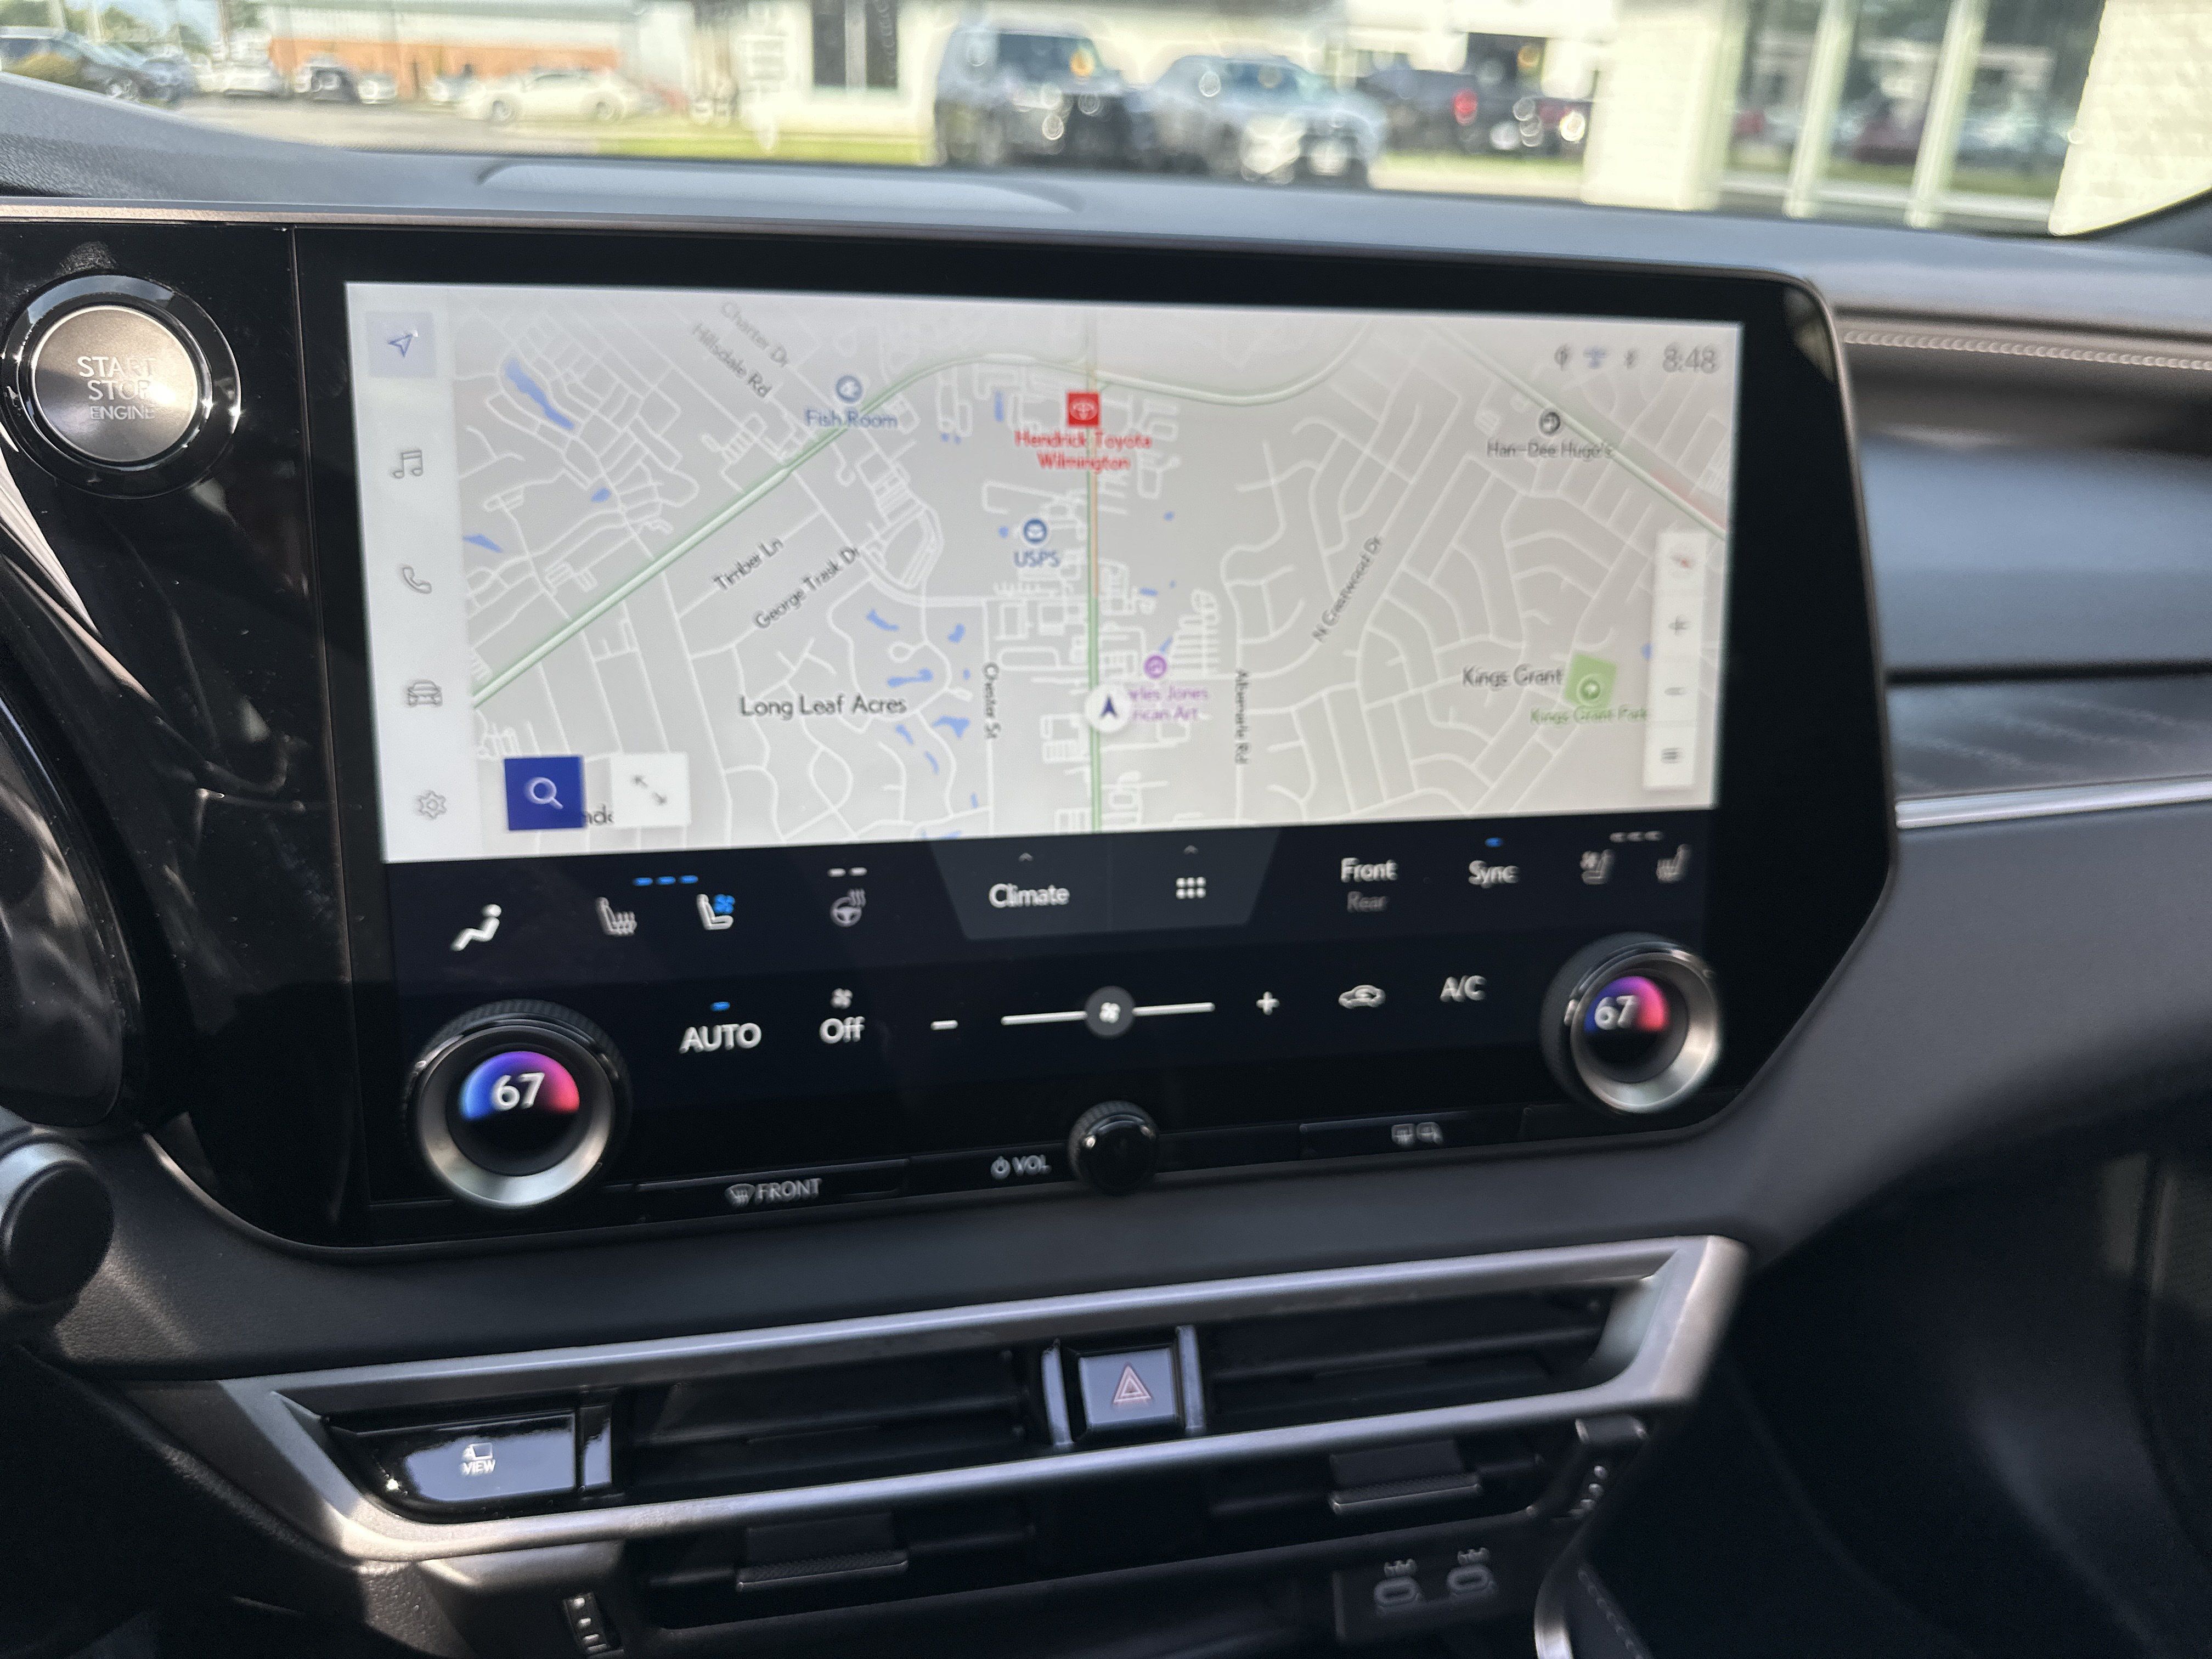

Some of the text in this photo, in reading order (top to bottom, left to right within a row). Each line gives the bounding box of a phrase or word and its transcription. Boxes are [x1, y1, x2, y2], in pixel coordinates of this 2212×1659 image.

[77, 356, 157, 377] START
[1662, 342, 1719, 374] 8:48
[87, 379, 151, 400] STOP
[747, 370, 773, 399] Rd
[90, 405, 155, 420] ENGINE
[804, 409, 898, 429] Fish Room
[1014, 428, 1152, 452] Hendrick Toyota
[1036, 452, 1131, 475] Wilmington
[713, 538, 783, 591] Timber Ln
[1014, 550, 1062, 568] USPS
[752, 546, 861, 629] George Trask Dr
[1311, 624, 1330, 643] N
[1363, 537, 1383, 555] Dr
[1462, 663, 1564, 692] Kings Grant
[739, 692, 907, 721] Long Leaf Acres
[1530, 707, 1569, 729] Kings
[1573, 704, 1612, 724] Grant
[1234, 742, 1251, 764] Rd
[1341, 857, 1398, 883] Front
[1468, 860, 1520, 889] Sync
[989, 883, 1070, 908] Climate
[1347, 890, 1389, 913] Rear
[1440, 975, 1487, 1003] A/C
[1594, 995, 1638, 1030] 67
[679, 1023, 762, 1053] AUTO
[819, 1015, 866, 1044] Off
[492, 1072, 545, 1111] 67
[1012, 1154, 1052, 1176] VOL
[754, 1177, 823, 1204] FRONT
[461, 1459, 496, 1476] VIEW
